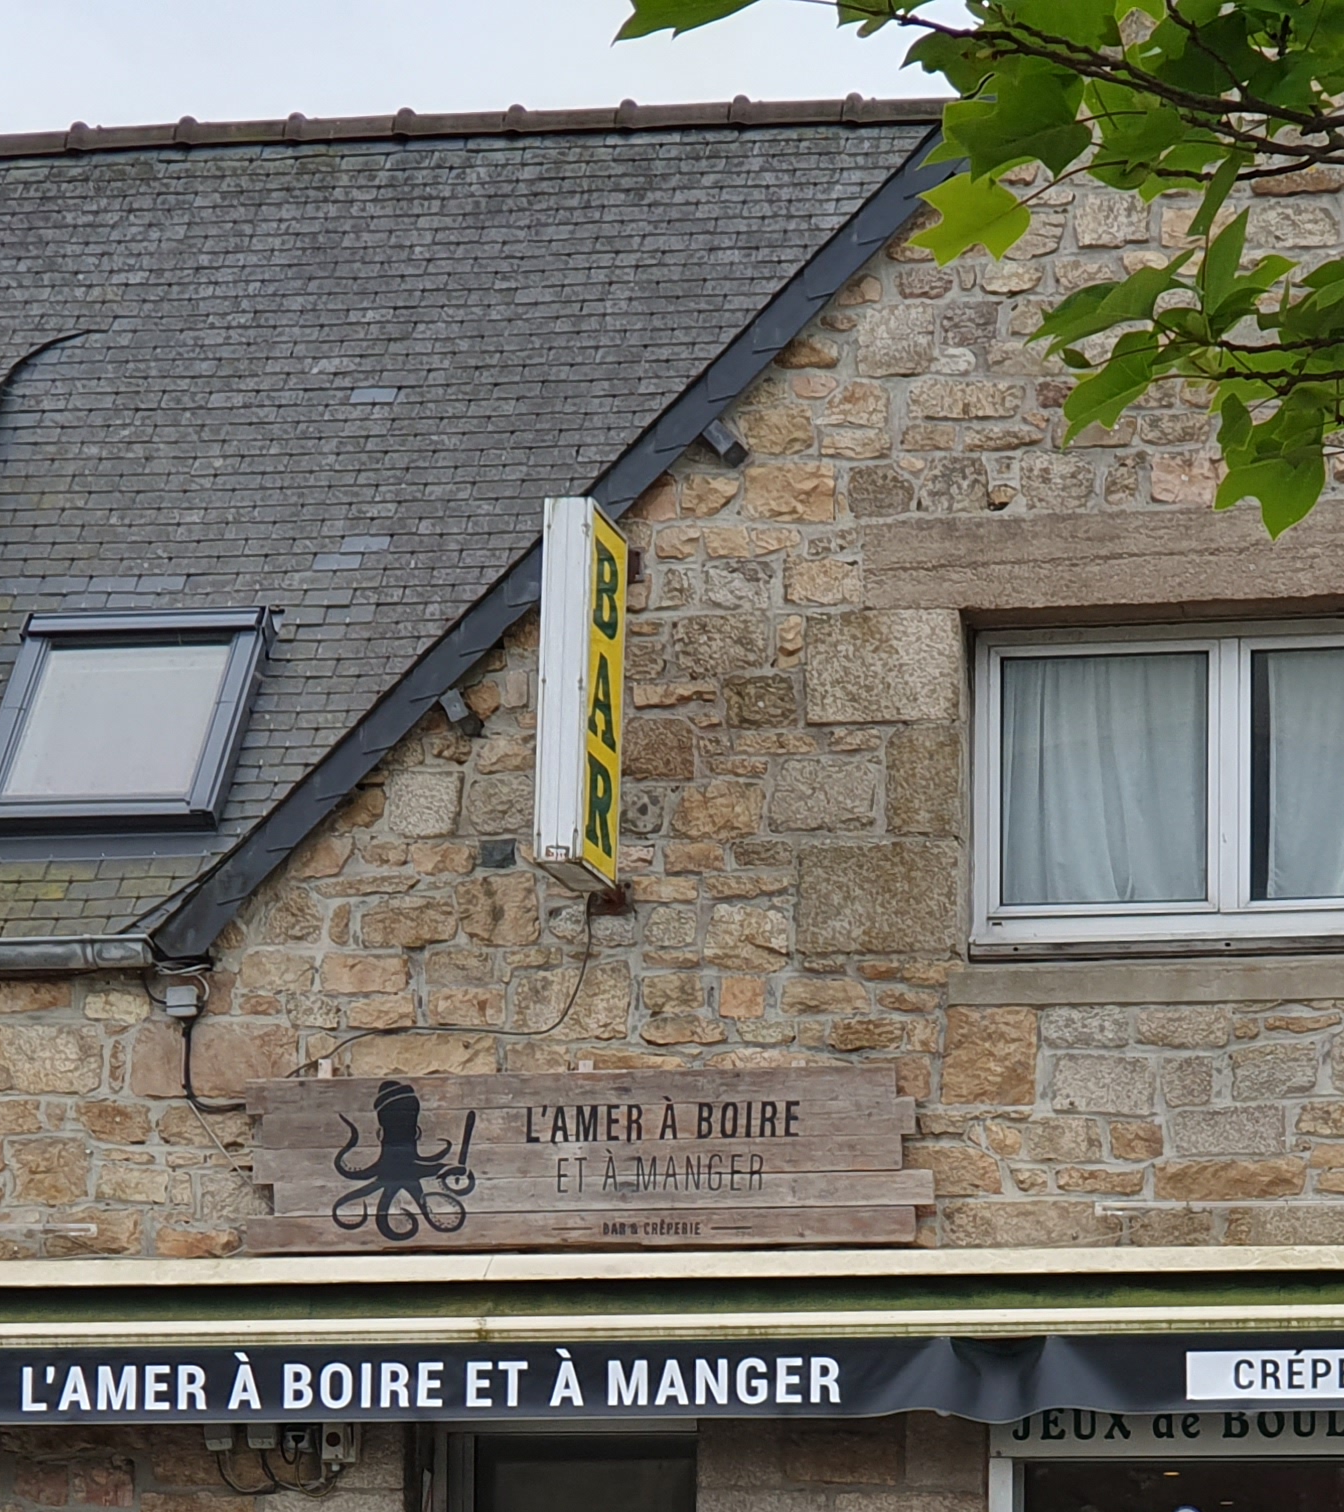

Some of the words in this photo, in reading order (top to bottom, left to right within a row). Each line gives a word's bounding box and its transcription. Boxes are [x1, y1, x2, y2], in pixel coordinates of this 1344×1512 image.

[586, 535, 619, 859] BAR
[525, 1102, 643, 1144] L'AMER
[659, 1096, 678, 1140] À
[696, 1101, 800, 1139] BOIRE
[557, 1156, 587, 1193] ET
[603, 1148, 617, 1192] À
[635, 1153, 764, 1192] MANGER
[21, 1362, 207, 1411] L'AMER
[228, 1352, 262, 1410] À
[282, 1361, 445, 1410] BOIRE
[466, 1361, 529, 1408] ET
[549, 1349, 584, 1407] À
[607, 1357, 842, 1406] MANGER
[1012, 1408, 1132, 1441] JEUX
[1152, 1412, 1201, 1440] de
